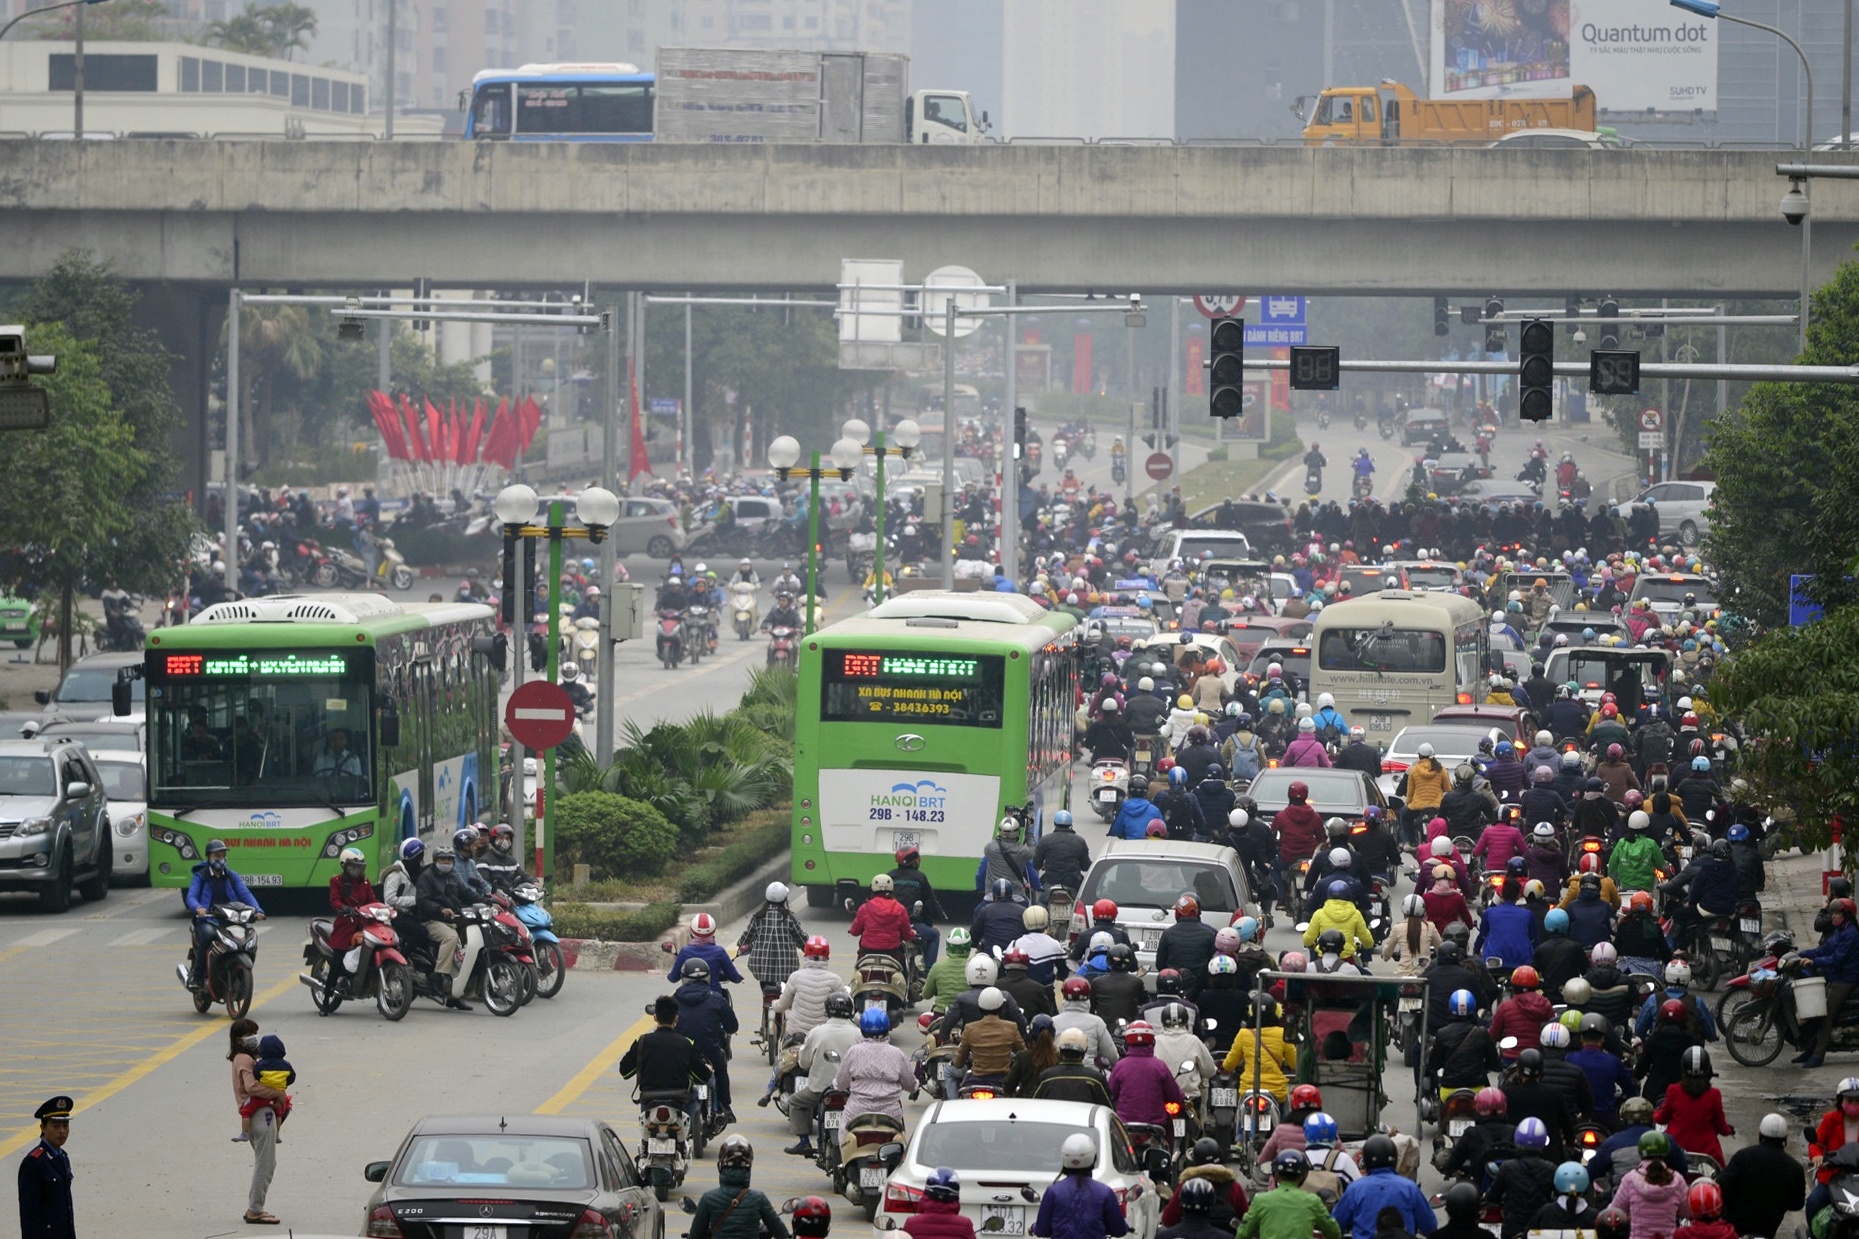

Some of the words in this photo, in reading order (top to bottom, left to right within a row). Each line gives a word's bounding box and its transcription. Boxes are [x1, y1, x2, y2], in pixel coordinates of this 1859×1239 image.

[1582, 23, 1671, 44] Quantum
[1675, 22, 1707, 42] dot
[1612, 45, 1628, 54] MÀU
[1663, 45, 1681, 55] CUỘC
[1669, 86, 1694, 95] SUHD
[1695, 86, 1707, 95] TV
[1247, 328, 1267, 342] DÀNH
[1267, 328, 1289, 342] RIÊNG
[1290, 330, 1304, 342] BRT
[844, 654, 881, 676] BRT
[1330, 674, 1433, 685] www.hillstate.com.vn
[873, 687, 891, 698] BUS
[928, 687, 942, 700] HÀ
[943, 688, 962, 703] NỘI
[893, 702, 950, 714] 38436393
[870, 794, 917, 807] HANOI
[919, 796, 946, 808] BRT
[869, 807, 892, 820] 29B
[905, 809, 945, 822] 148.23
[899, 833, 914, 842] 29B
[474, 1226, 497, 1239] 29A
